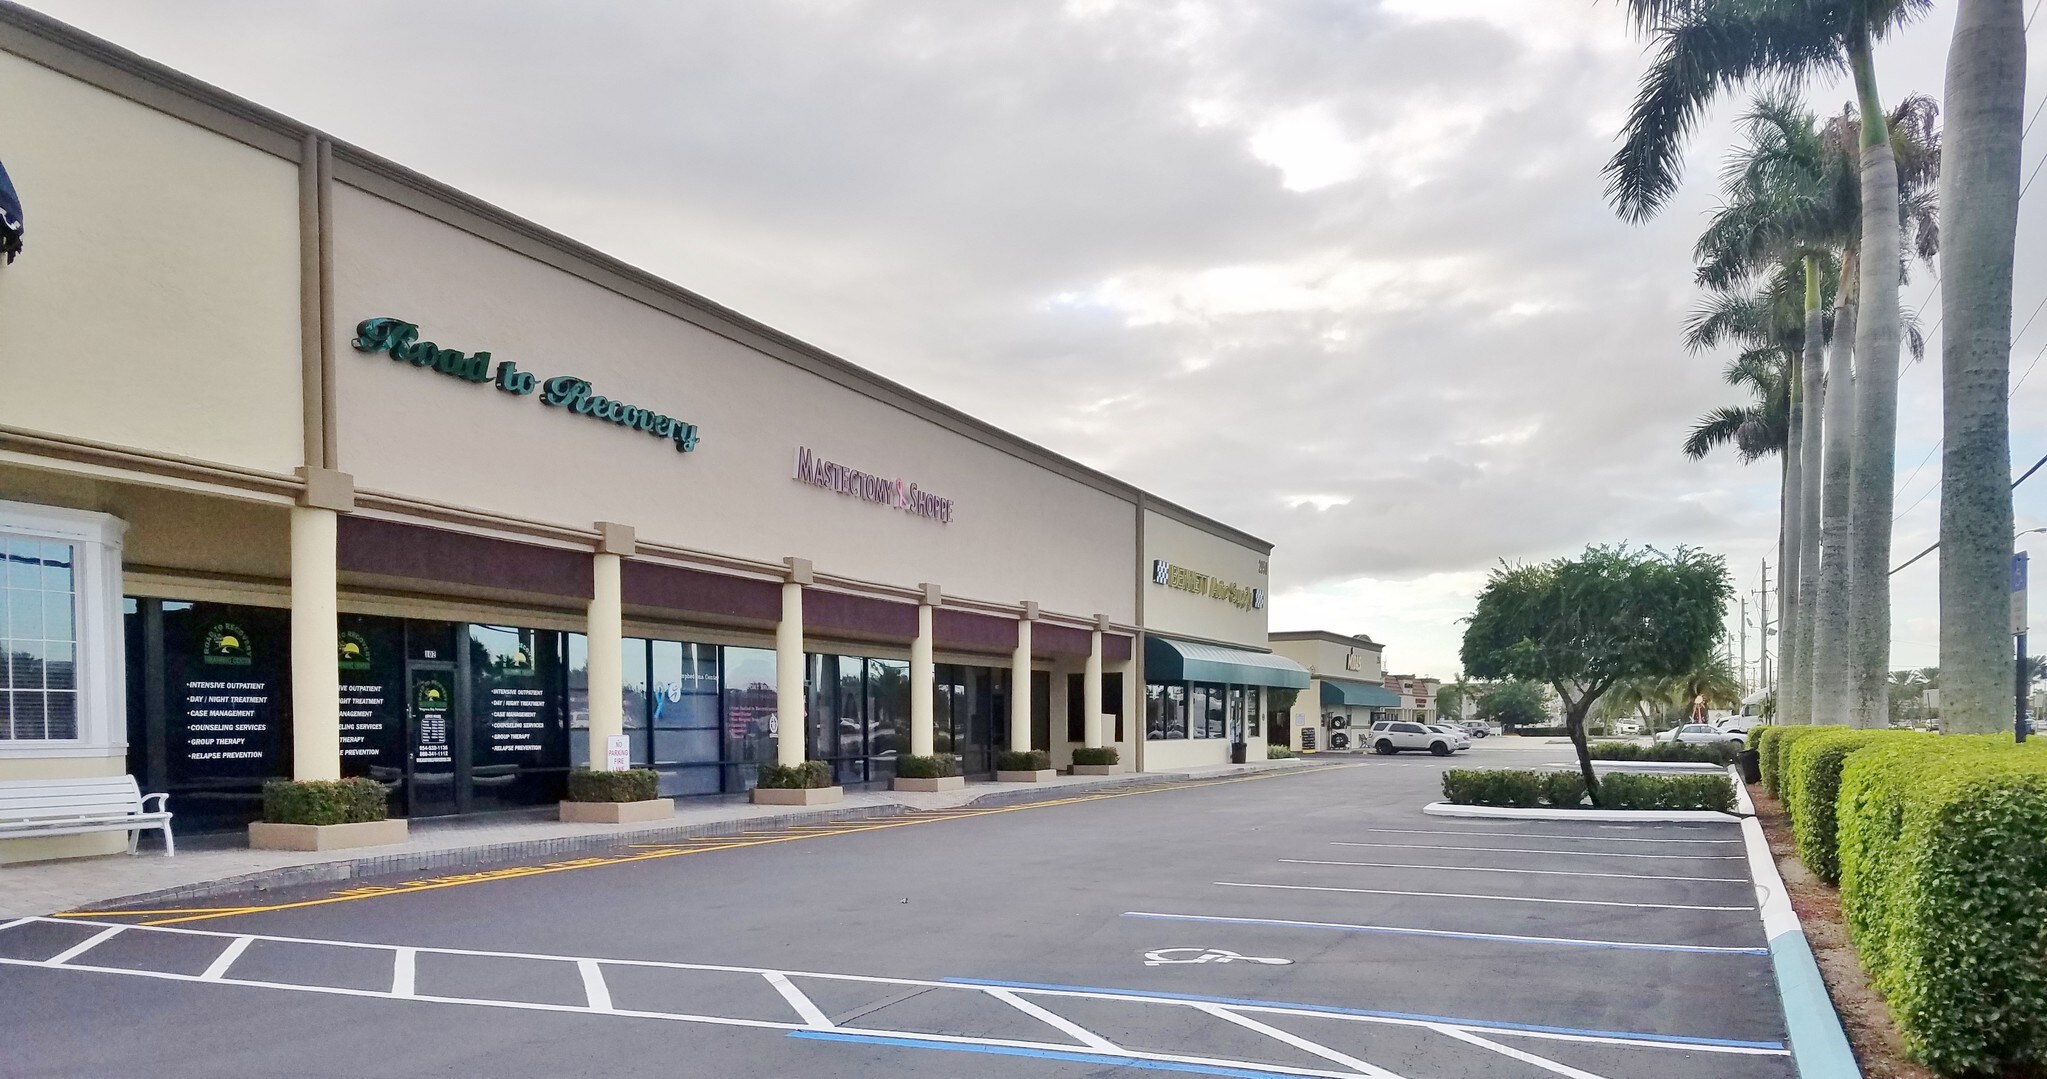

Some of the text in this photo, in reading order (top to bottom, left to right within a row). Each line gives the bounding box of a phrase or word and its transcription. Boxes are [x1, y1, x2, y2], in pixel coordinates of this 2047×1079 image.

[351, 317, 700, 453] Road to Recovery
[1168, 564, 1210, 596] BENNETT
[225, 622, 252, 656] RECOVERY
